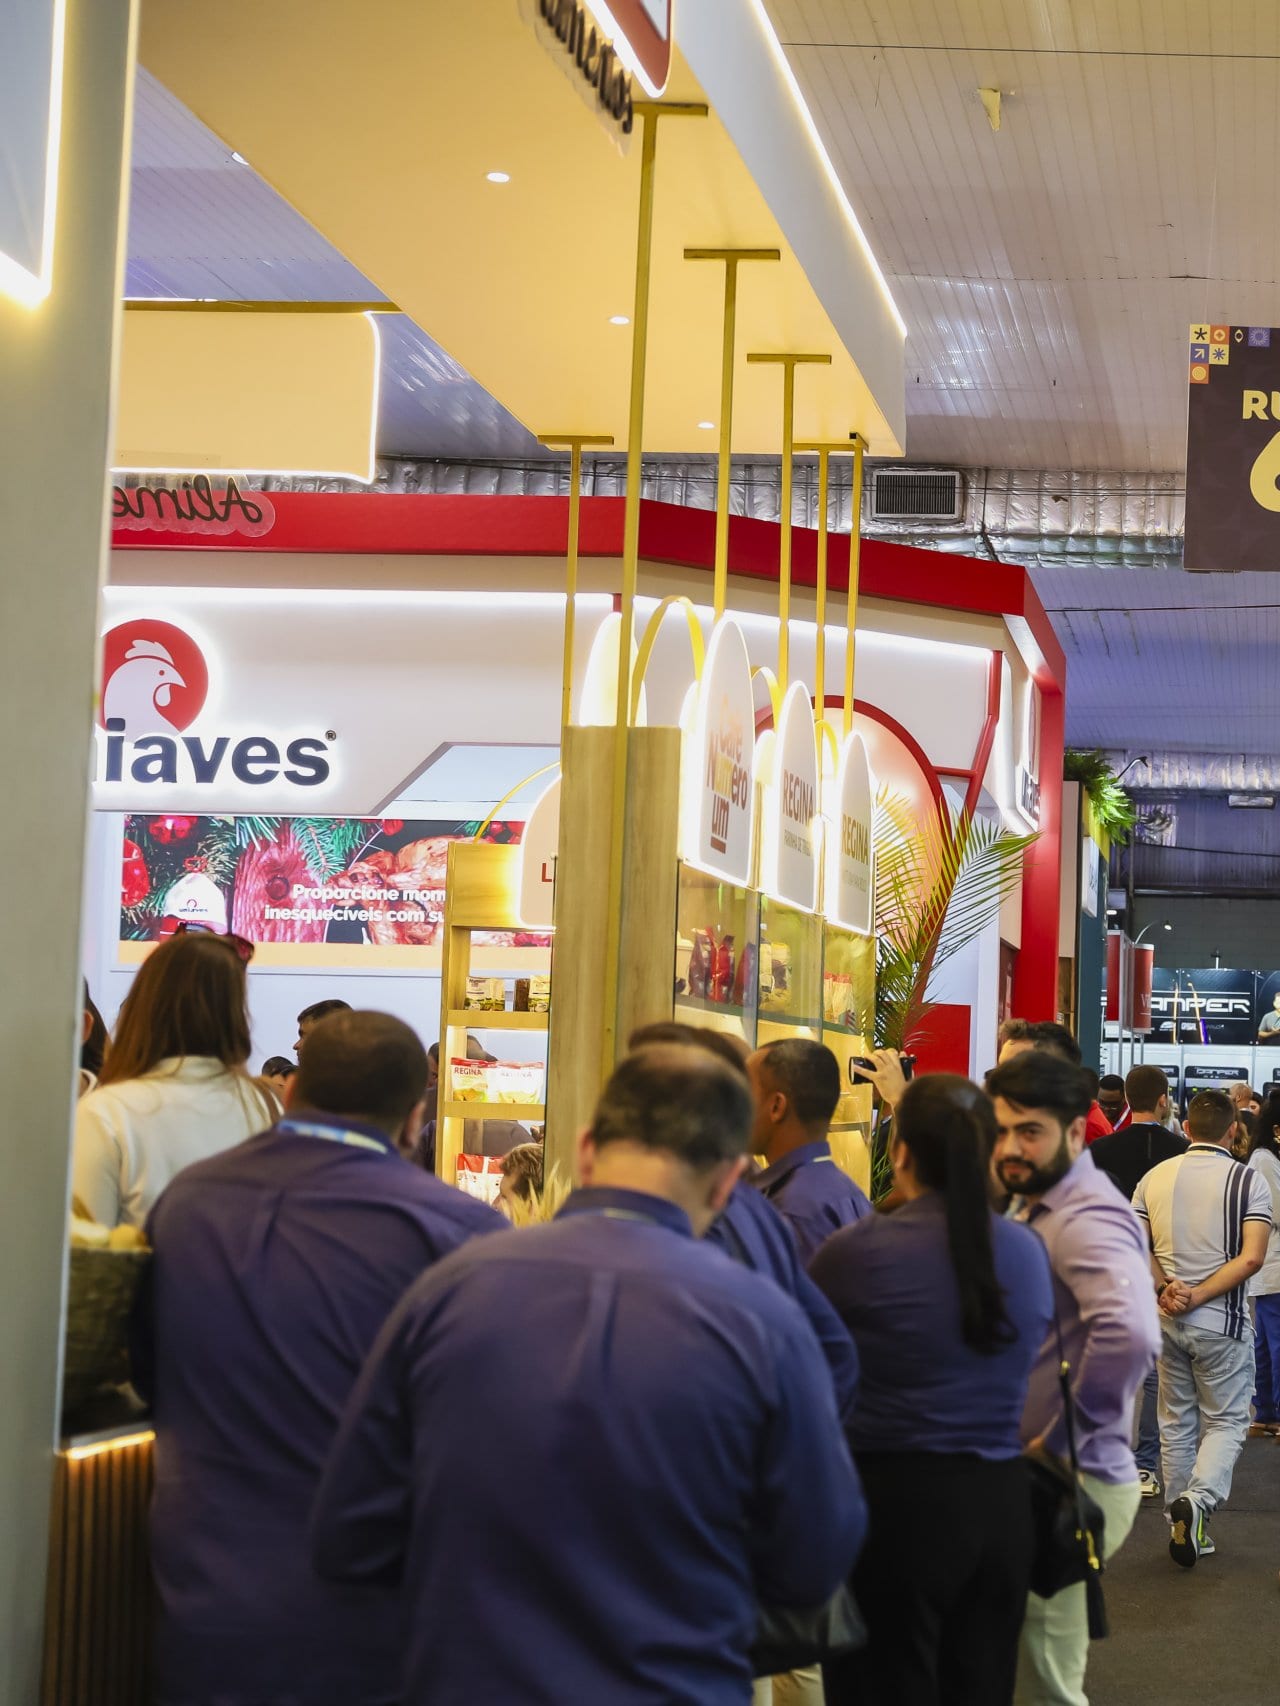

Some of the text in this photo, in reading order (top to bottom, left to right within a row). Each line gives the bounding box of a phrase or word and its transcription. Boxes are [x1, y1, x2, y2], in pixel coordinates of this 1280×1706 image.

[95, 718, 330, 786] iaves
[783, 769, 814, 826] REGINA
[841, 813, 869, 866] REGINA
[292, 884, 400, 903] Proporcione
[264, 905, 383, 924] inesquecíveis
[386, 909, 425, 922] com
[454, 1066, 482, 1076] REGINA
